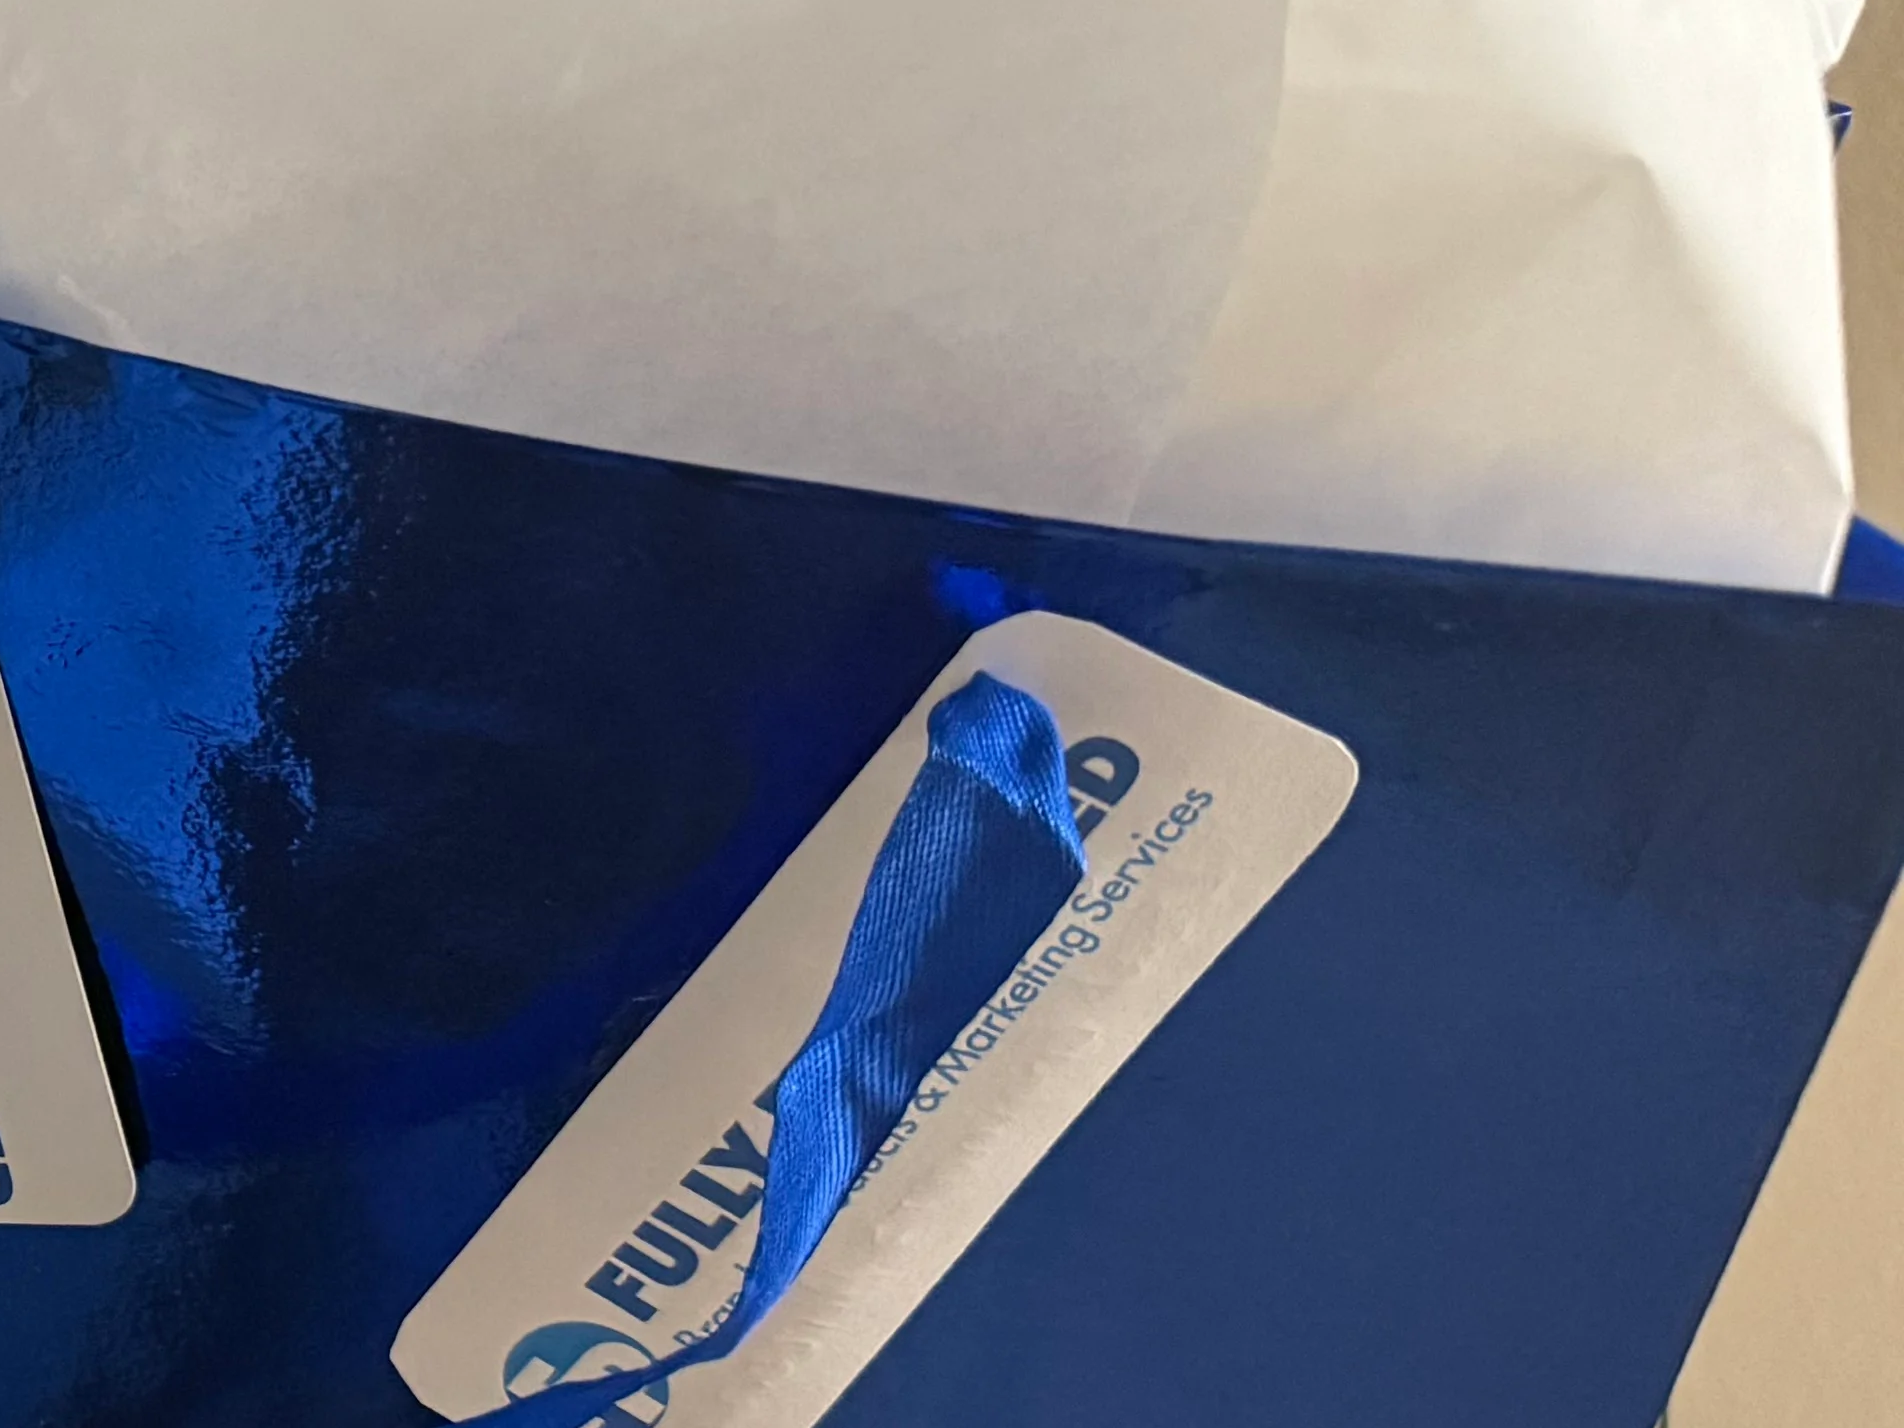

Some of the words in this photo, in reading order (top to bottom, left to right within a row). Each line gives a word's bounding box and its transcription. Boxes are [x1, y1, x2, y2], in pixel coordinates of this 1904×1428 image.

[914, 1085, 948, 1113] &
[935, 924, 1100, 1085] Marketing
[1071, 787, 1213, 922] Services
[584, 1120, 770, 1322] FULLY
